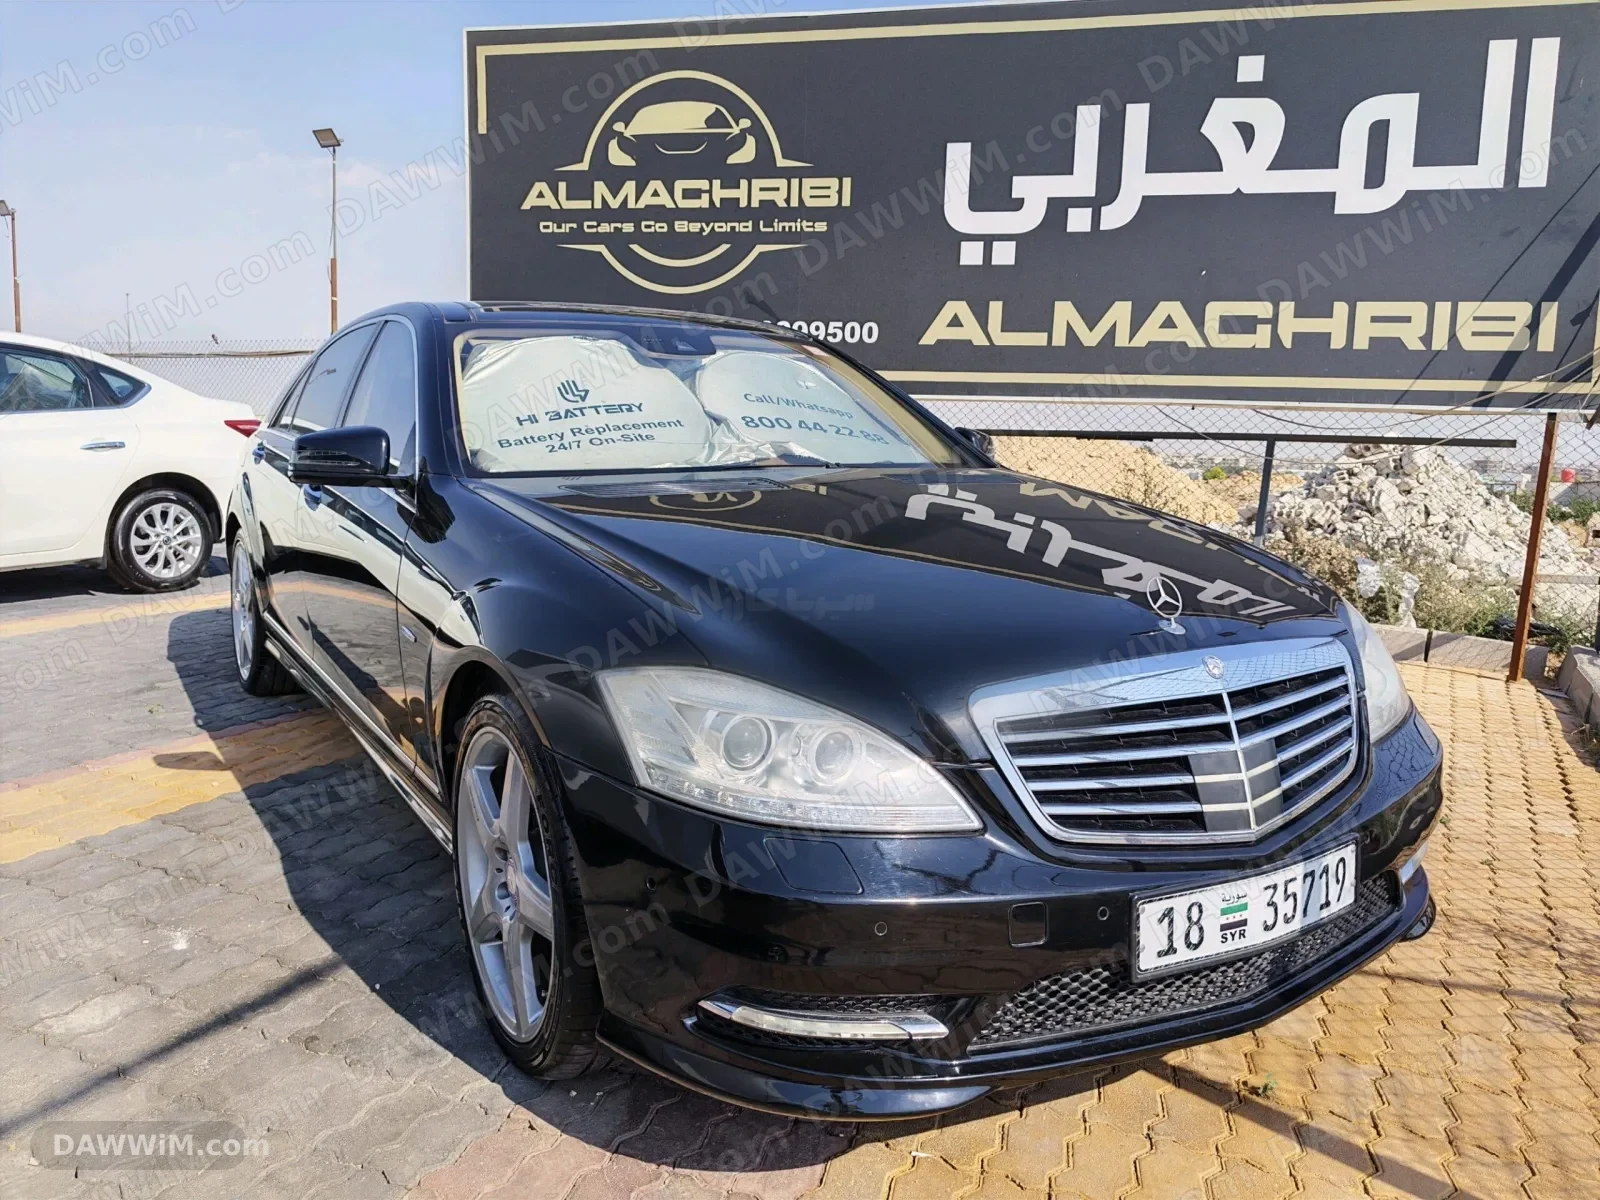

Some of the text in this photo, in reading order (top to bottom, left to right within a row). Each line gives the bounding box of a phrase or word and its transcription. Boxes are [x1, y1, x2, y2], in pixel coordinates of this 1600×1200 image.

[944, 37, 1560, 265] المغربي
[520, 177, 852, 210] ALMAGHRIBI
[539, 218, 828, 236] Our Cars Go Beyond Limits
[919, 300, 1558, 352] ALMAGHRIBI
[517, 402, 644, 427] HI BATTERY
[743, 392, 854, 420] Call/Whatsapp
[498, 417, 685, 449] Battery Replacement
[545, 431, 656, 454] 24/7 On-Site
[741, 415, 890, 446] 800 44 22 88
[1157, 856, 1347, 958] 18 35719
[1221, 928, 1247, 944] SYR
